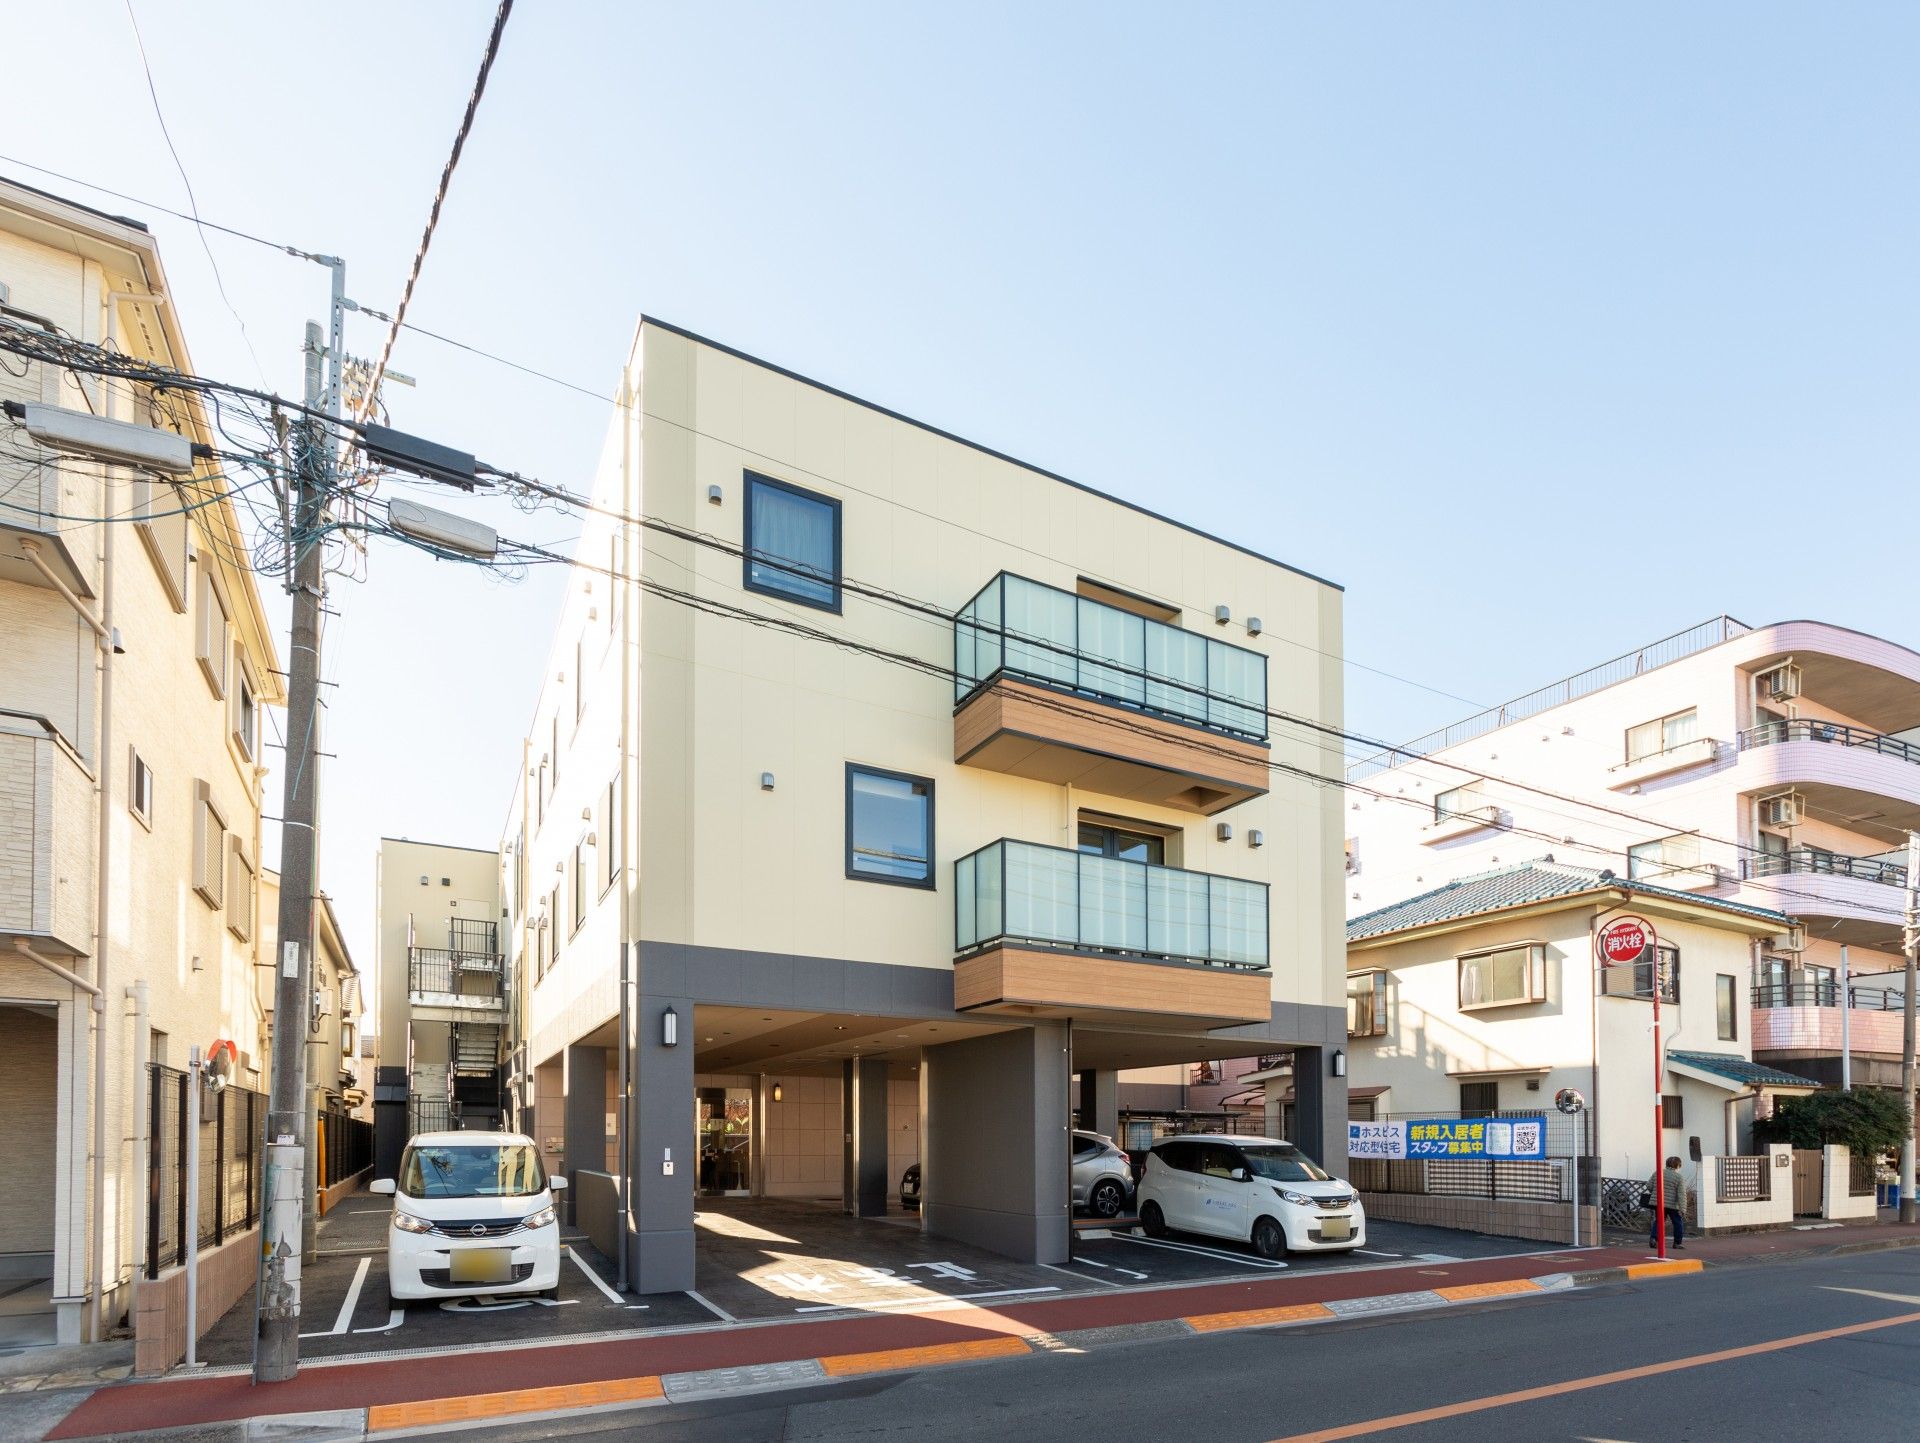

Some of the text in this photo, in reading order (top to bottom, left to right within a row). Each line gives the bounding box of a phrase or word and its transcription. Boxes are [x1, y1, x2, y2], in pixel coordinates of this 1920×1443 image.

[1607, 932, 1643, 952] 消火栓
[1361, 1126, 1400, 1138] ホスピス
[1411, 1123, 1484, 1140] 新規入居者
[1349, 1141, 1401, 1154] 対応型住宅
[1410, 1141, 1483, 1154] スタッフ募集中
